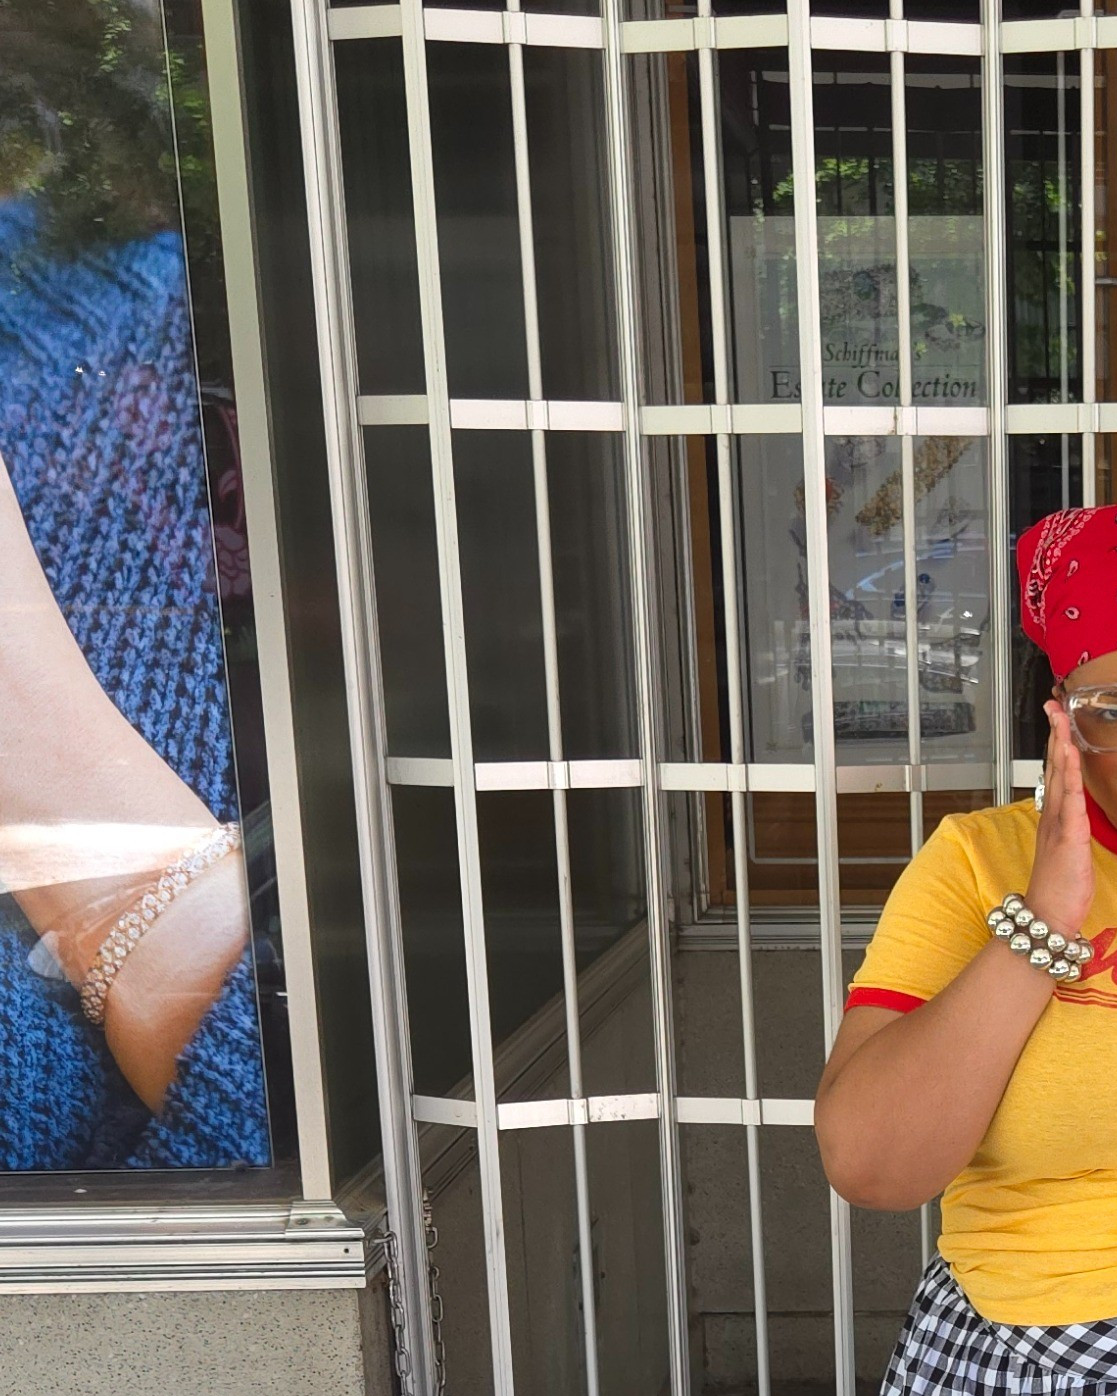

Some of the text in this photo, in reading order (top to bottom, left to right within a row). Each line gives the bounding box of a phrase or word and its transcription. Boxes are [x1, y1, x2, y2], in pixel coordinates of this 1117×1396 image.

[823, 342, 923, 369] Schiffmas
[769, 370, 977, 400] Este Colection
